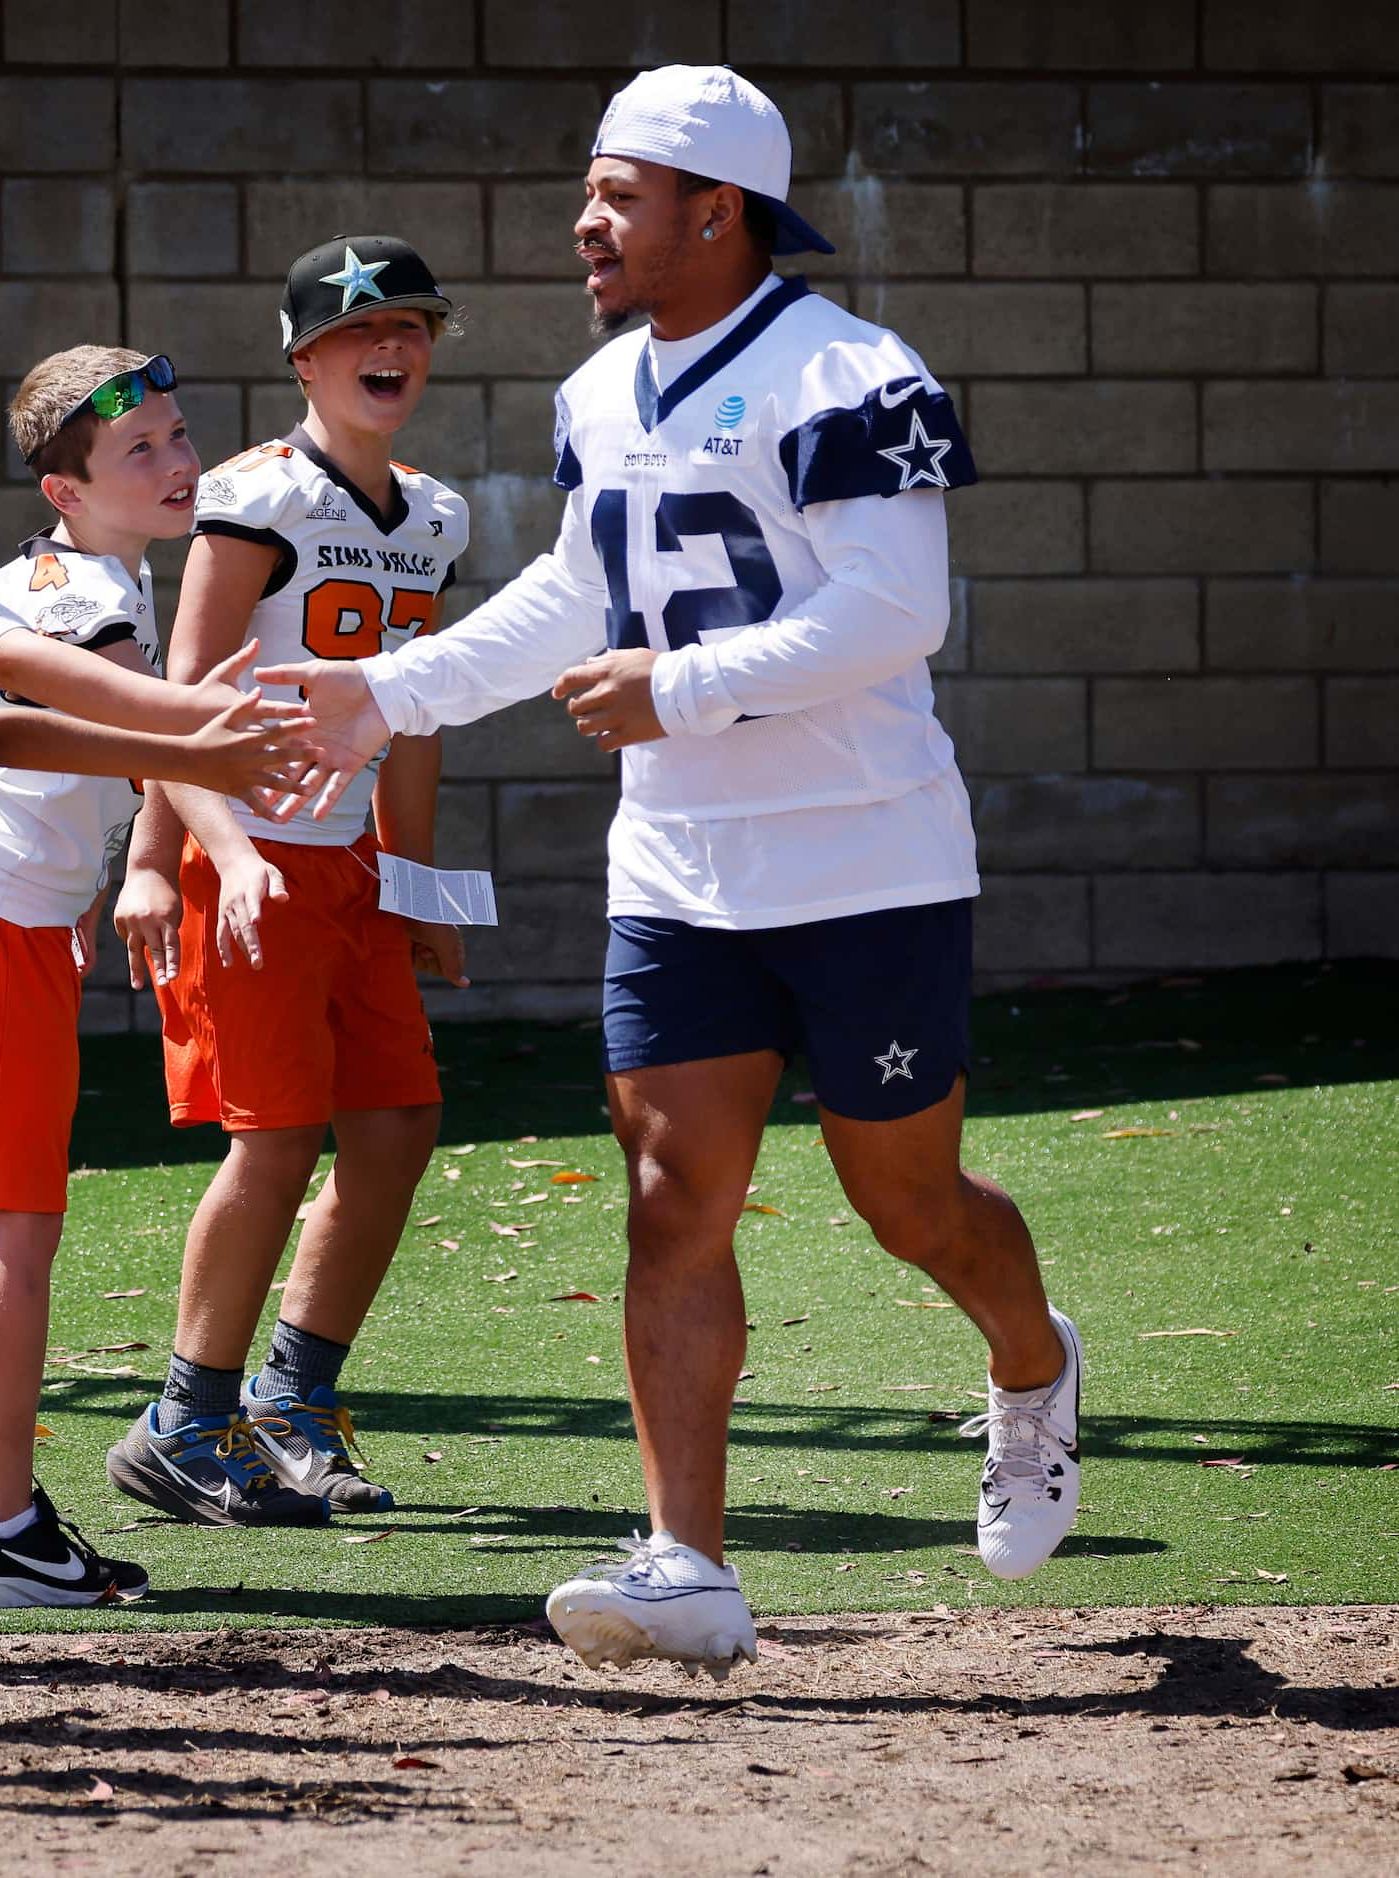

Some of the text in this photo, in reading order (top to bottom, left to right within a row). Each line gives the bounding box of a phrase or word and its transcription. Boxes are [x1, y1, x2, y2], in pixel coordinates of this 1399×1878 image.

[703, 437, 743, 456] AT&T
[318, 545, 373, 568] SIMI
[591, 489, 784, 652] 12
[29, 553, 70, 592] 4
